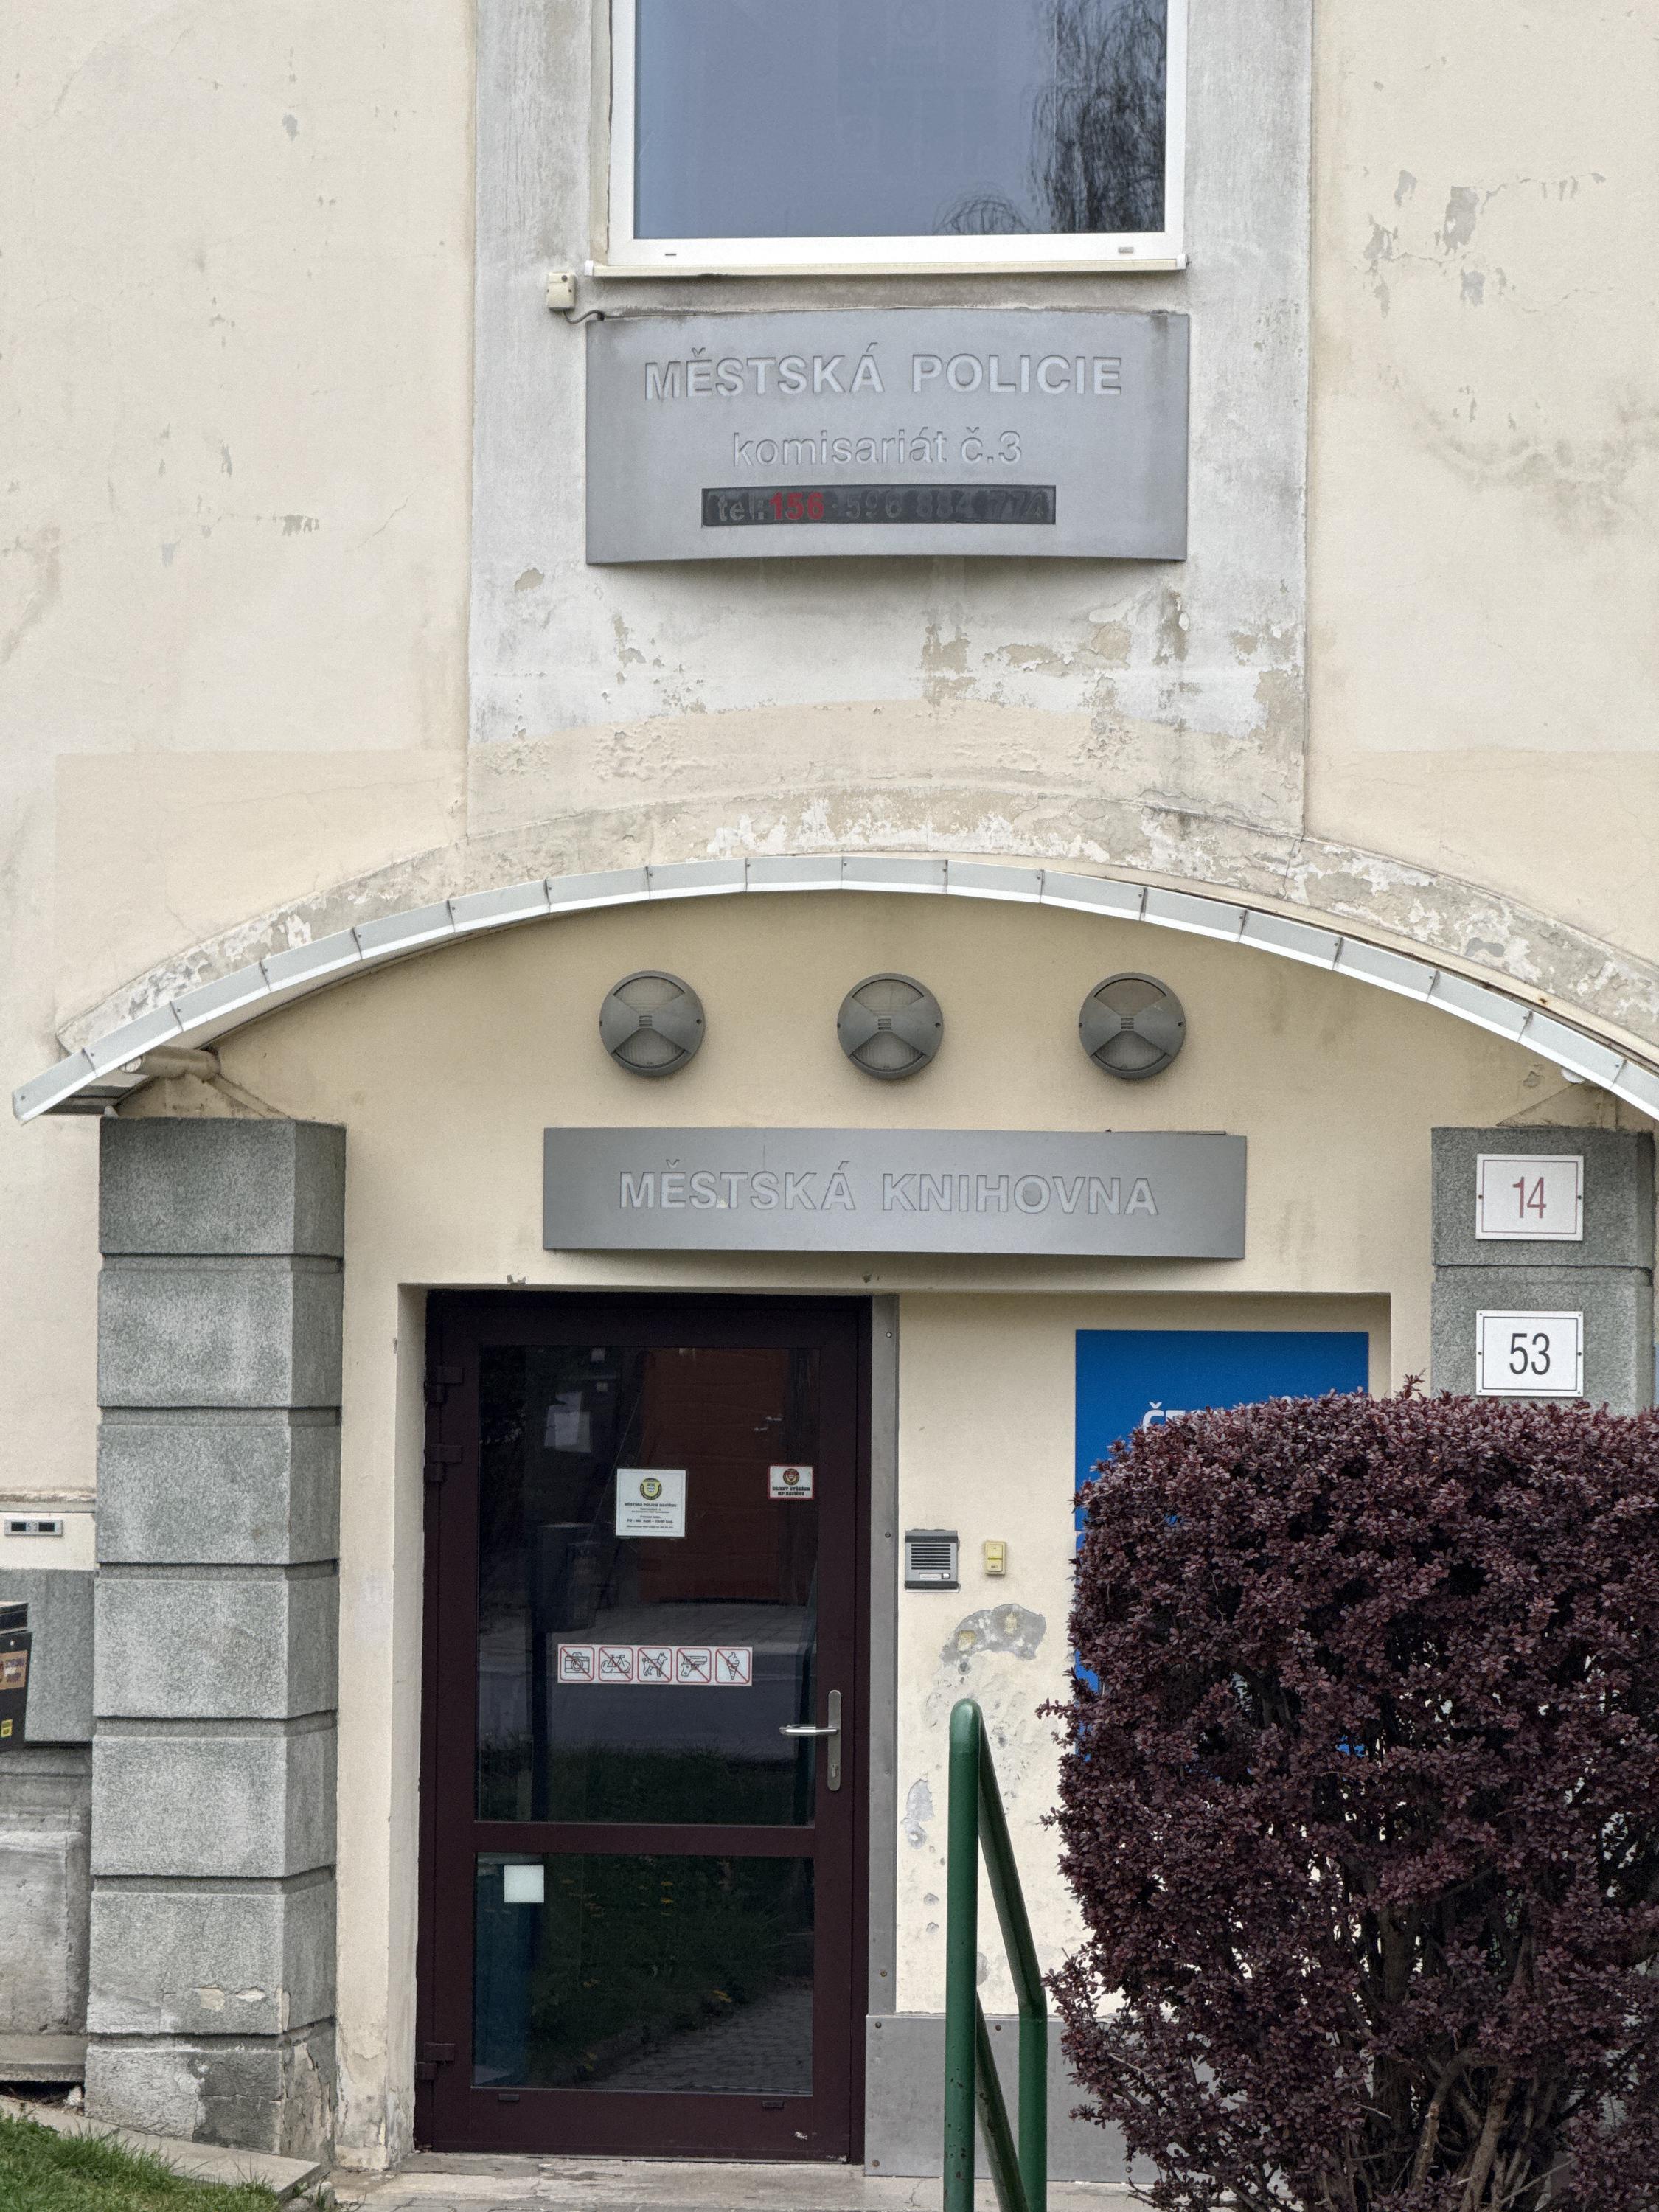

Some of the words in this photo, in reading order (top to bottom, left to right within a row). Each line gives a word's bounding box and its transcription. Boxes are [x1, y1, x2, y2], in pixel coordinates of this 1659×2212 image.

[644, 341, 886, 400] MĚSTSKÁ
[911, 352, 1122, 395] POLICIE
[733, 426, 947, 467] komisariát
[845, 491, 903, 520] 596
[618, 1158, 857, 1211] MĚSTSKÁ
[882, 1172, 1160, 1216] KNIHOVNA
[1512, 1176, 1548, 1220] 14
[1509, 1332, 1551, 1376] 53
